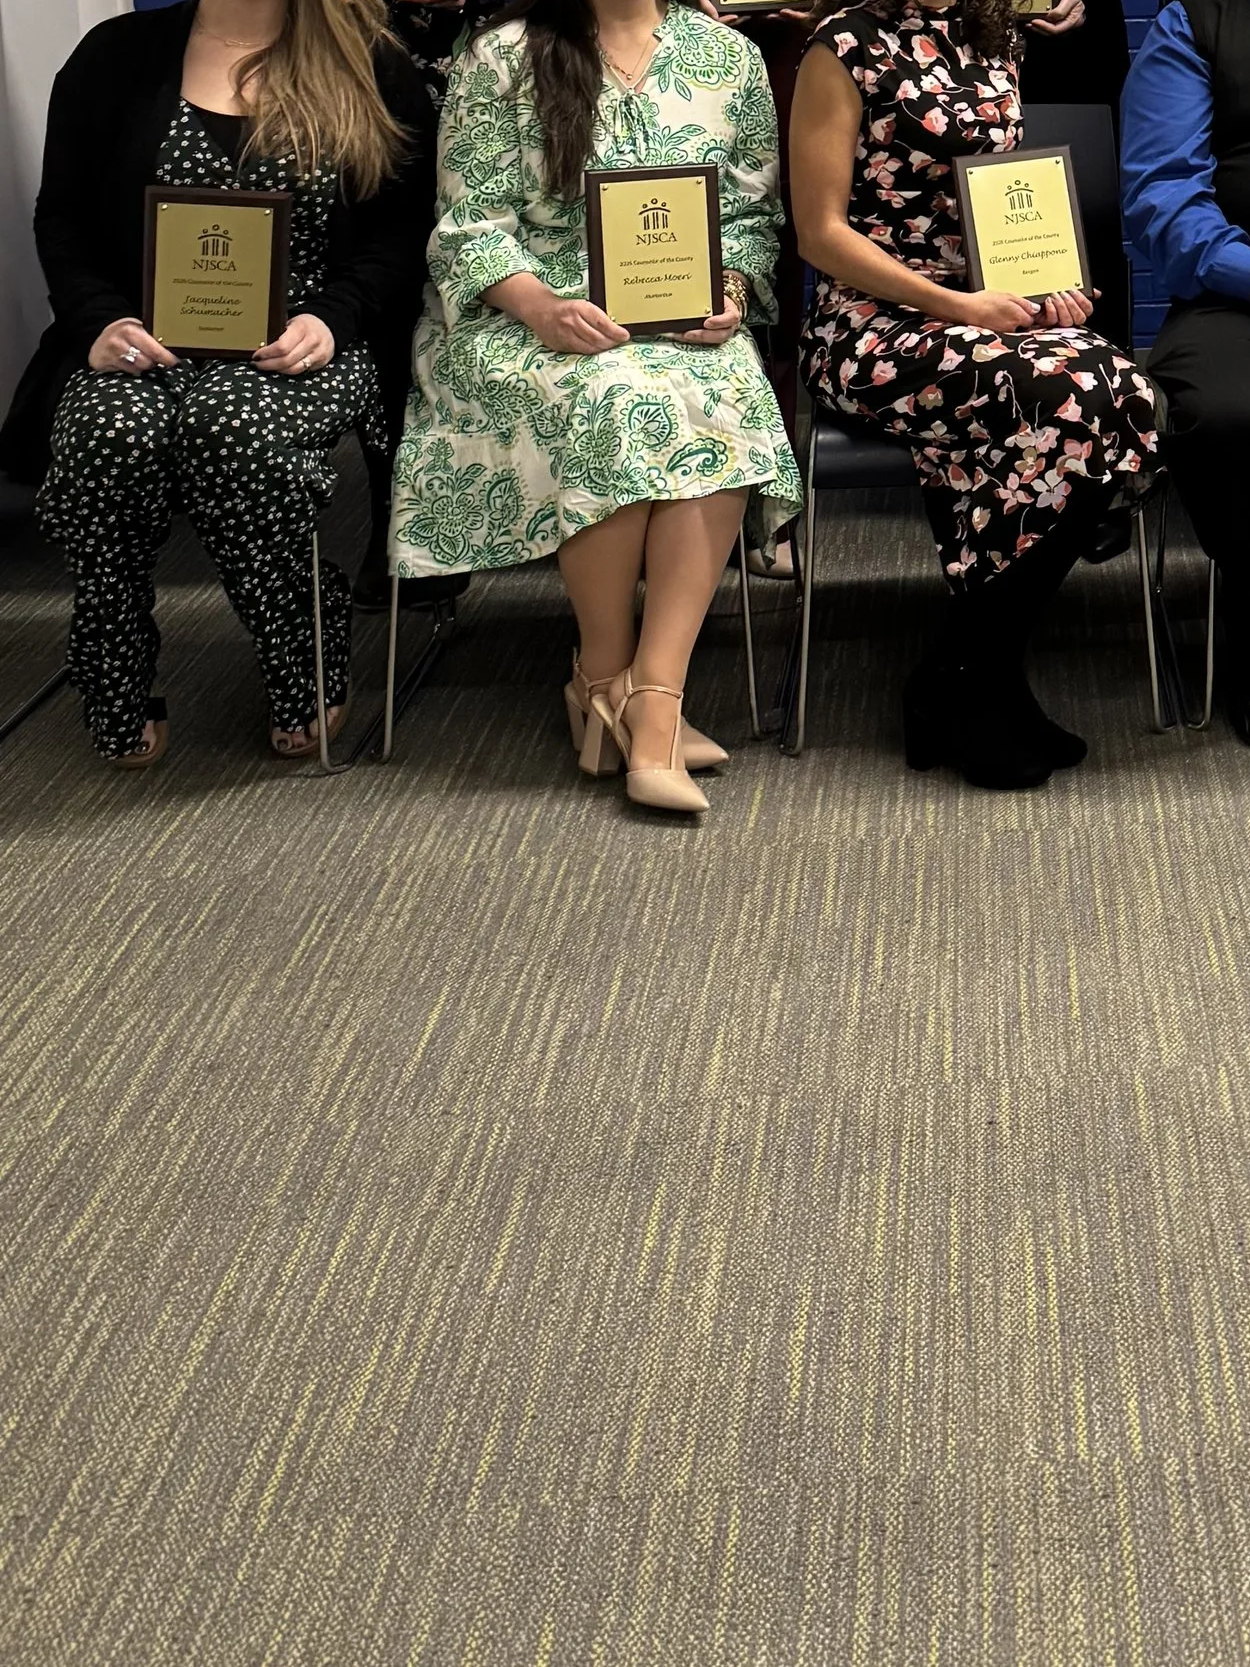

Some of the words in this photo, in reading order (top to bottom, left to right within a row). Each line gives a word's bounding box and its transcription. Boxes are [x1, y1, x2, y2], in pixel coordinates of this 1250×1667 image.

[1004, 210, 1043, 225] NJSCA
[635, 231, 677, 246] NJSCA
[192, 259, 237, 272] NJSCA
[623, 276, 663, 286] Rebecca
